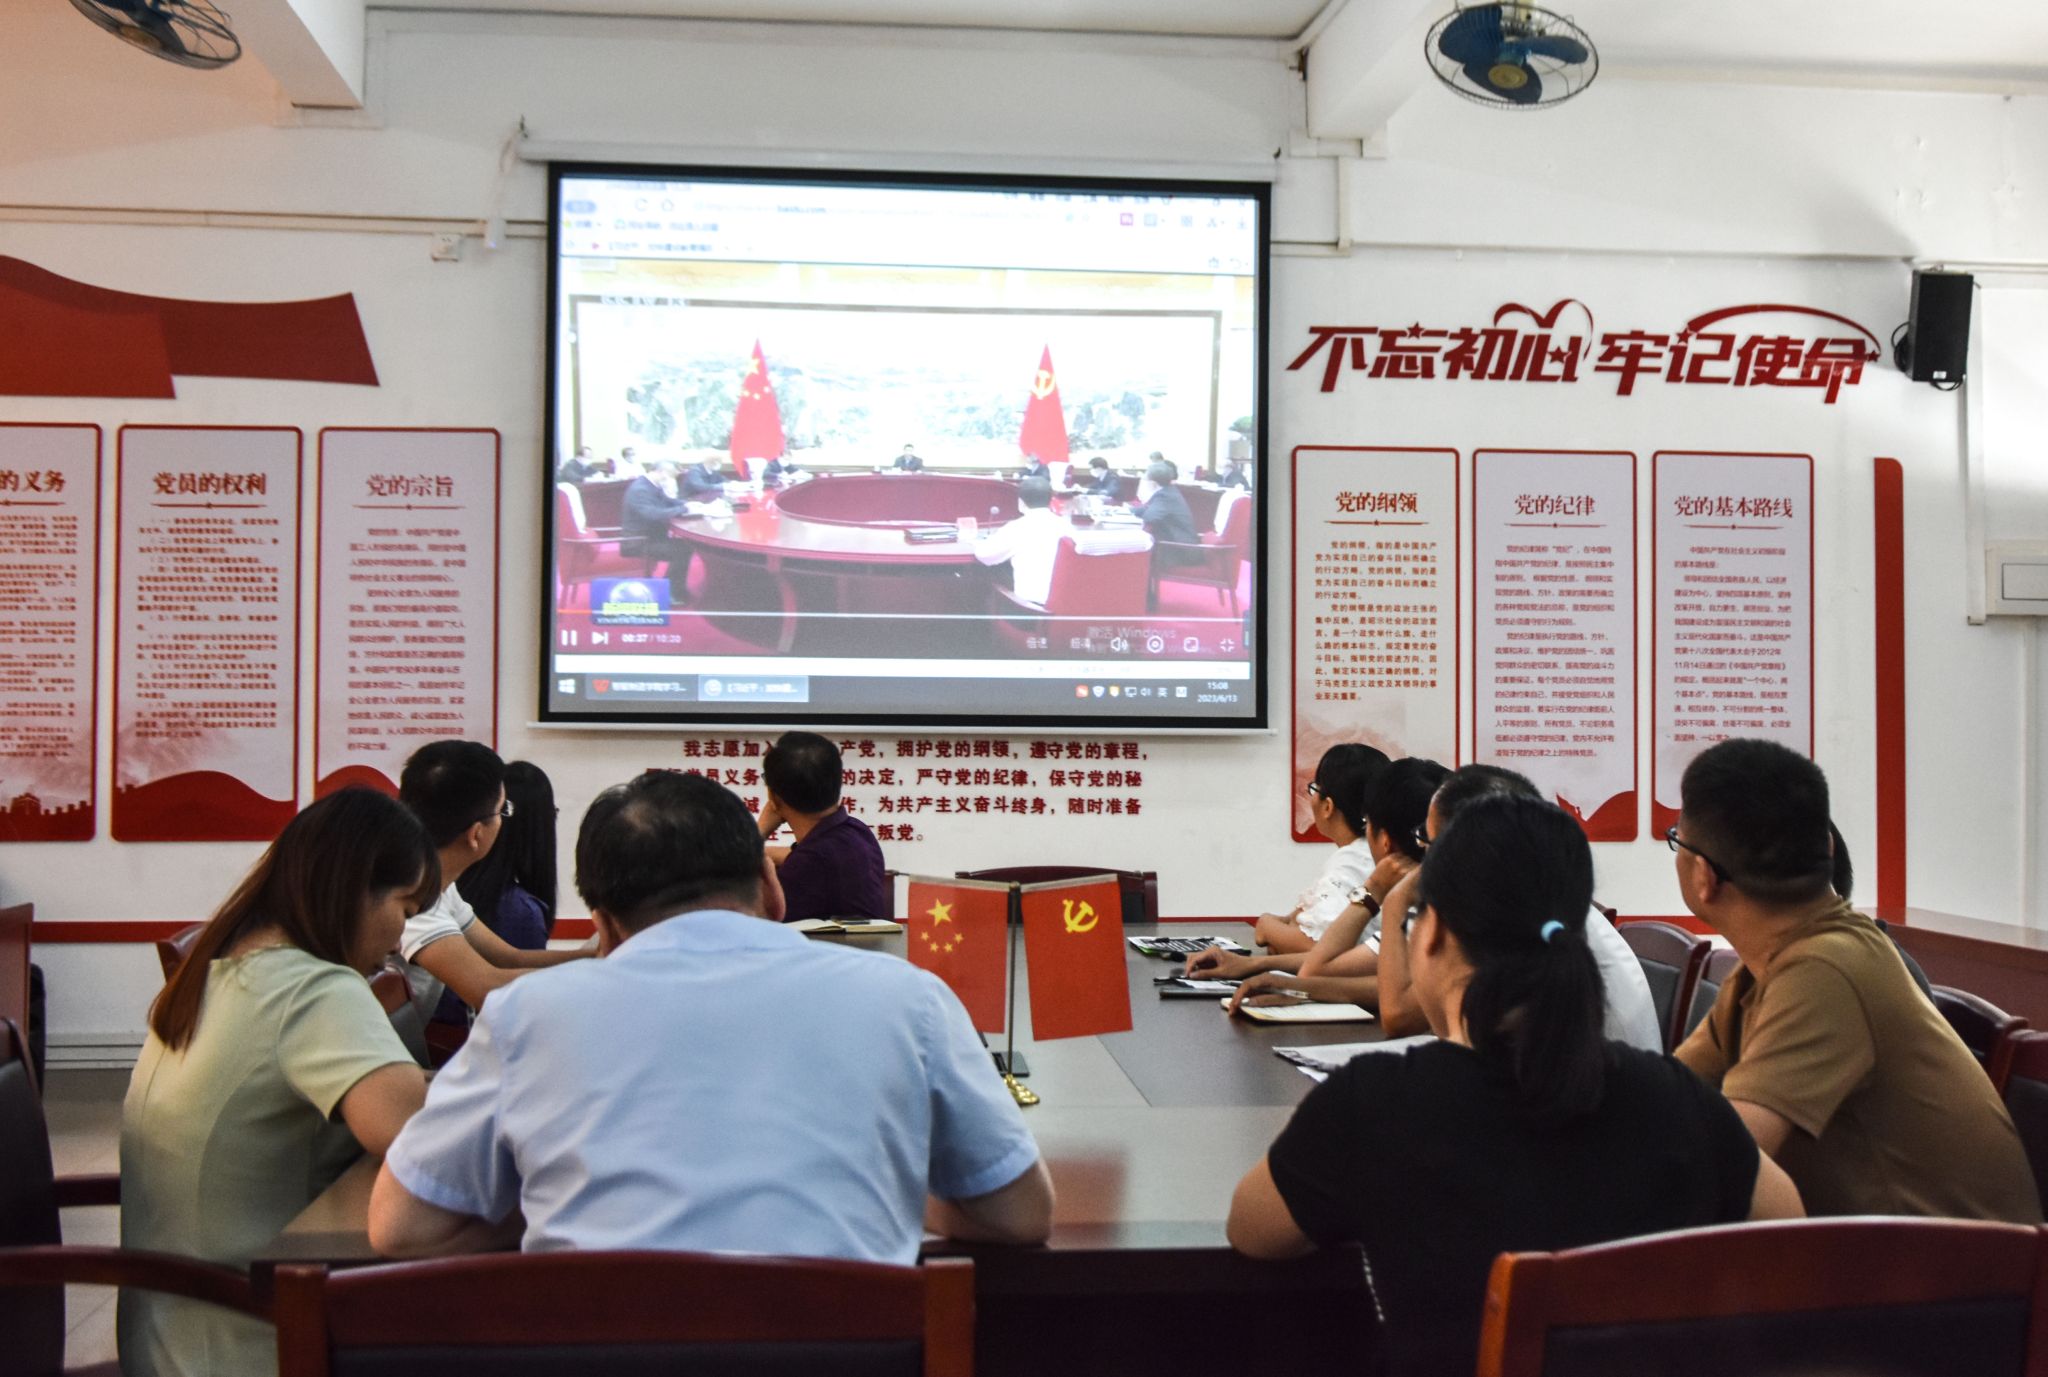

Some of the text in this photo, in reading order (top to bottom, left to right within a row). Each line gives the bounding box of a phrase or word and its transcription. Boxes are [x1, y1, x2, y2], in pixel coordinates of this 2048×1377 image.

[0, 469, 66, 494] 的义务
[153, 471, 267, 496] 党员的权利
[365, 474, 454, 498] 党的宗旨
[1335, 490, 1419, 514] 党的纲领
[1514, 493, 1596, 517] 党的纪律
[1673, 495, 1794, 519] 党的基本路线
